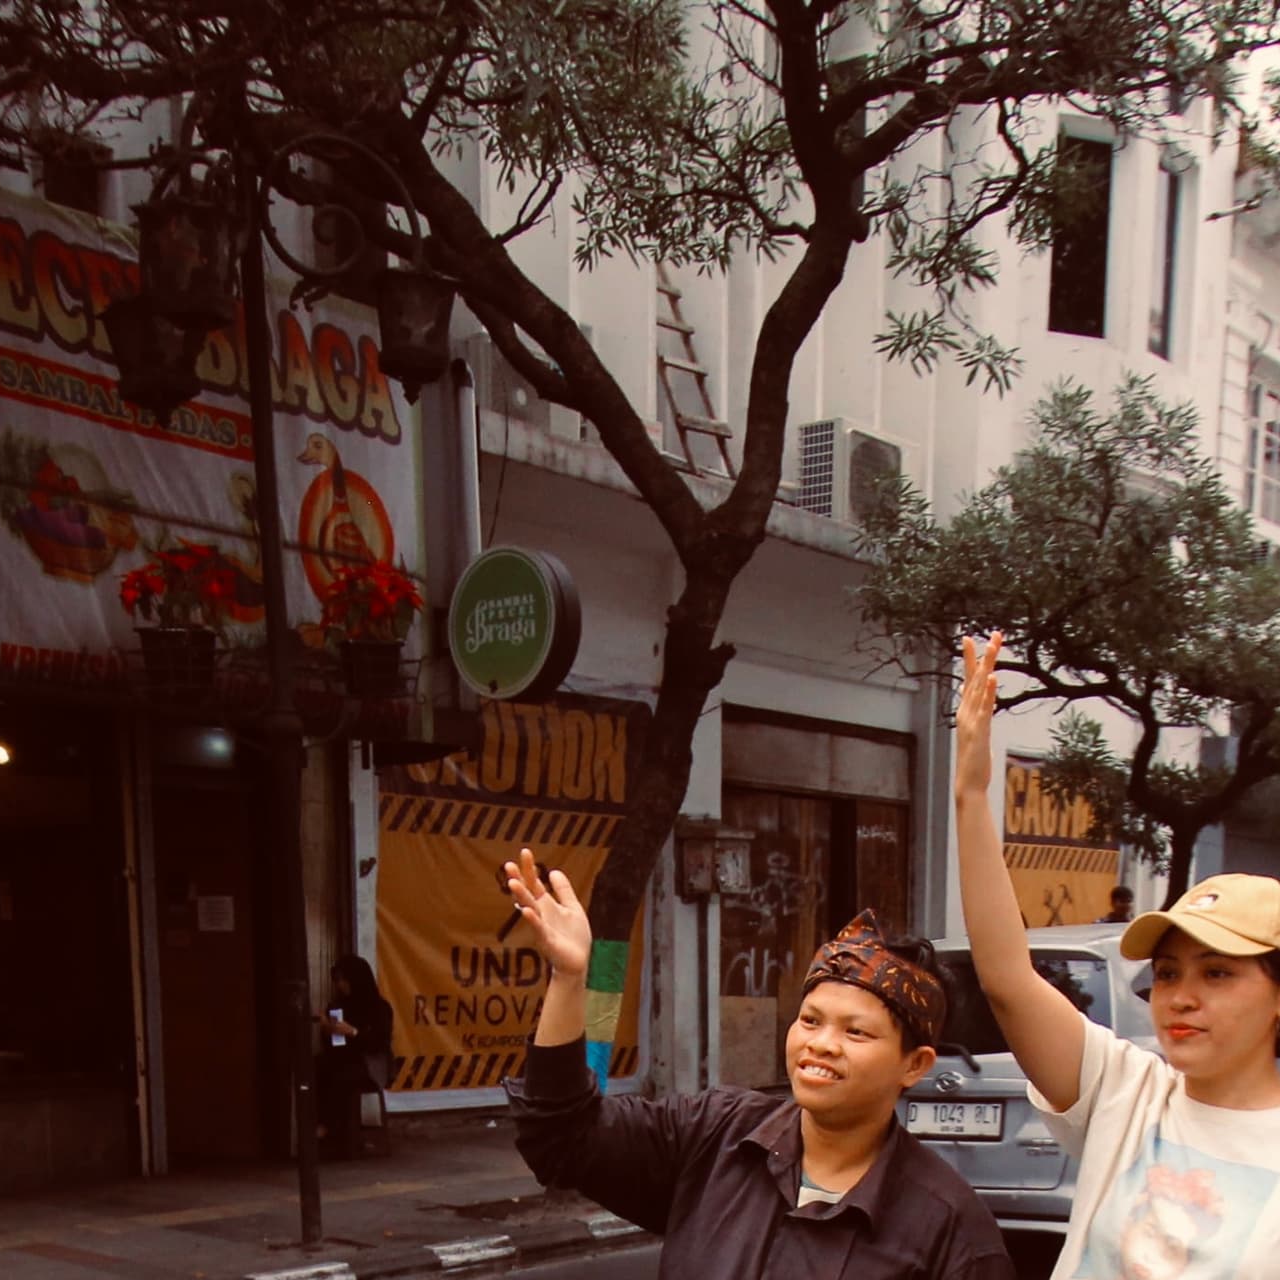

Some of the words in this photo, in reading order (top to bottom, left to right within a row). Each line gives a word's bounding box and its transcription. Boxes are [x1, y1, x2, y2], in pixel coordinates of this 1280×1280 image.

[135, 405, 239, 449] PDAS
[465, 599, 536, 653] Braga
[452, 946, 553, 987] UND
[908, 1104, 918, 1122] D
